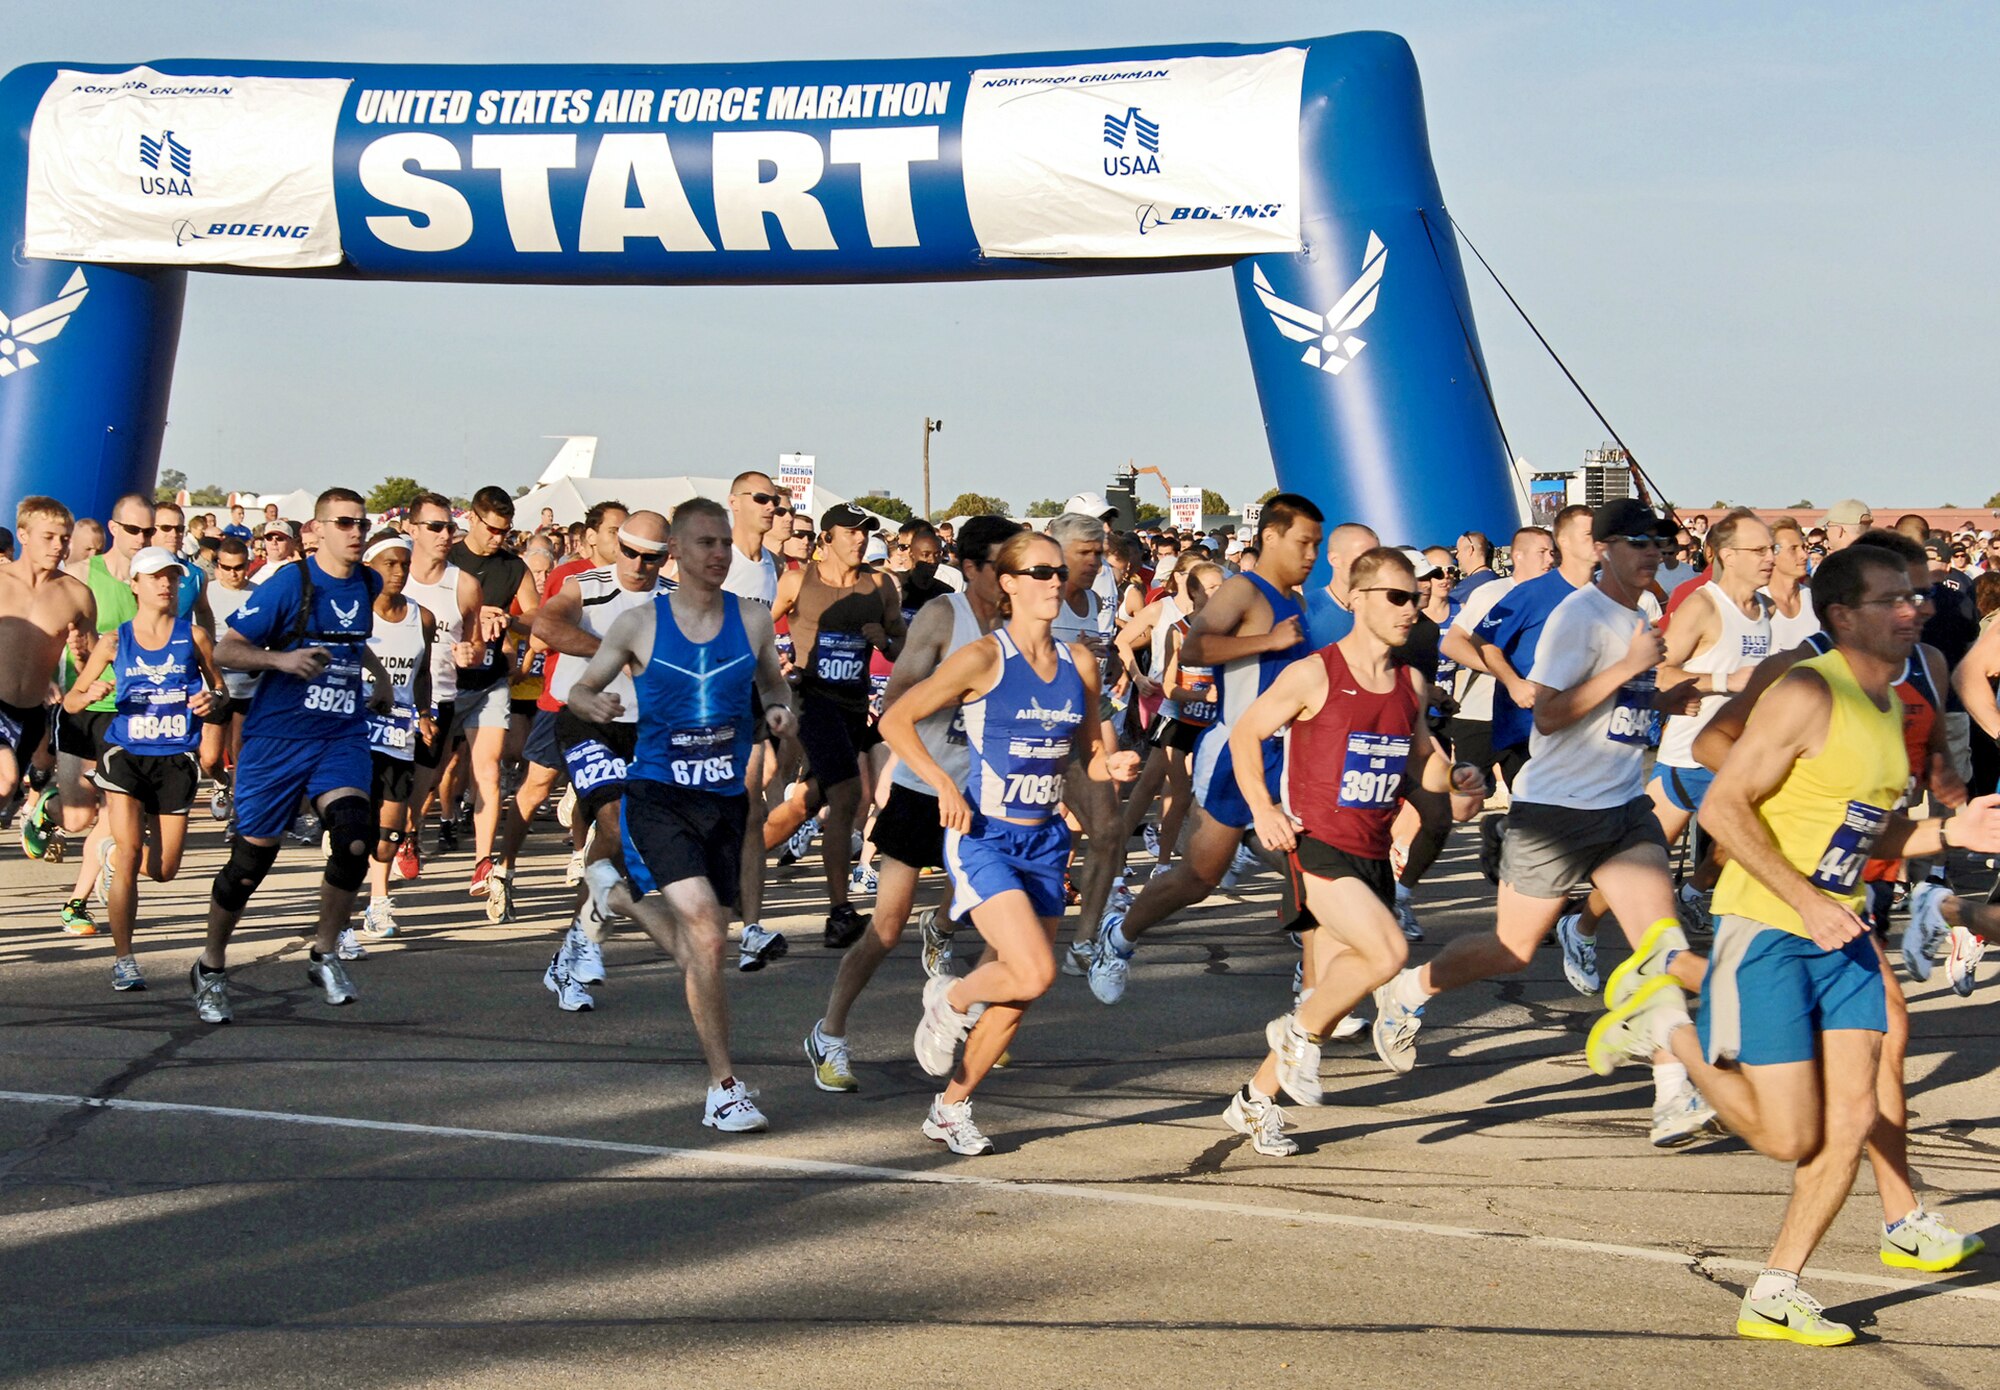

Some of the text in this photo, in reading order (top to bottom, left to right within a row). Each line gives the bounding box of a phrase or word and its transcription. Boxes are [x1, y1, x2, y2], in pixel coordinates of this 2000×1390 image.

[72, 81, 233, 95] NORTP GRUMMAN
[983, 70, 1169, 88] NORTHROP GRUMMAN
[356, 81, 951, 125] UNITED STATES AIR FORCE MARATHON
[1104, 155, 1160, 176] USAA
[140, 177, 193, 196] USAA
[358, 125, 939, 252] START
[207, 223, 310, 239] BOEING
[781, 467, 813, 475] MARATHON
[782, 476, 811, 484] EXPECTED
[787, 484, 806, 492] NISH
[1246, 508, 1260, 520] 1:5
[1742, 636, 1767, 645] BLUE
[378, 656, 414, 669] TIONA
[818, 658, 864, 680] 3002
[367, 673, 407, 685] GRD
[304, 685, 356, 714] 3926
[1016, 709, 1083, 723] AIR FORCE
[128, 714, 187, 740] 6849
[575, 758, 627, 790] 4226
[671, 755, 735, 785] 6785
[1341, 770, 1402, 802] 3912
